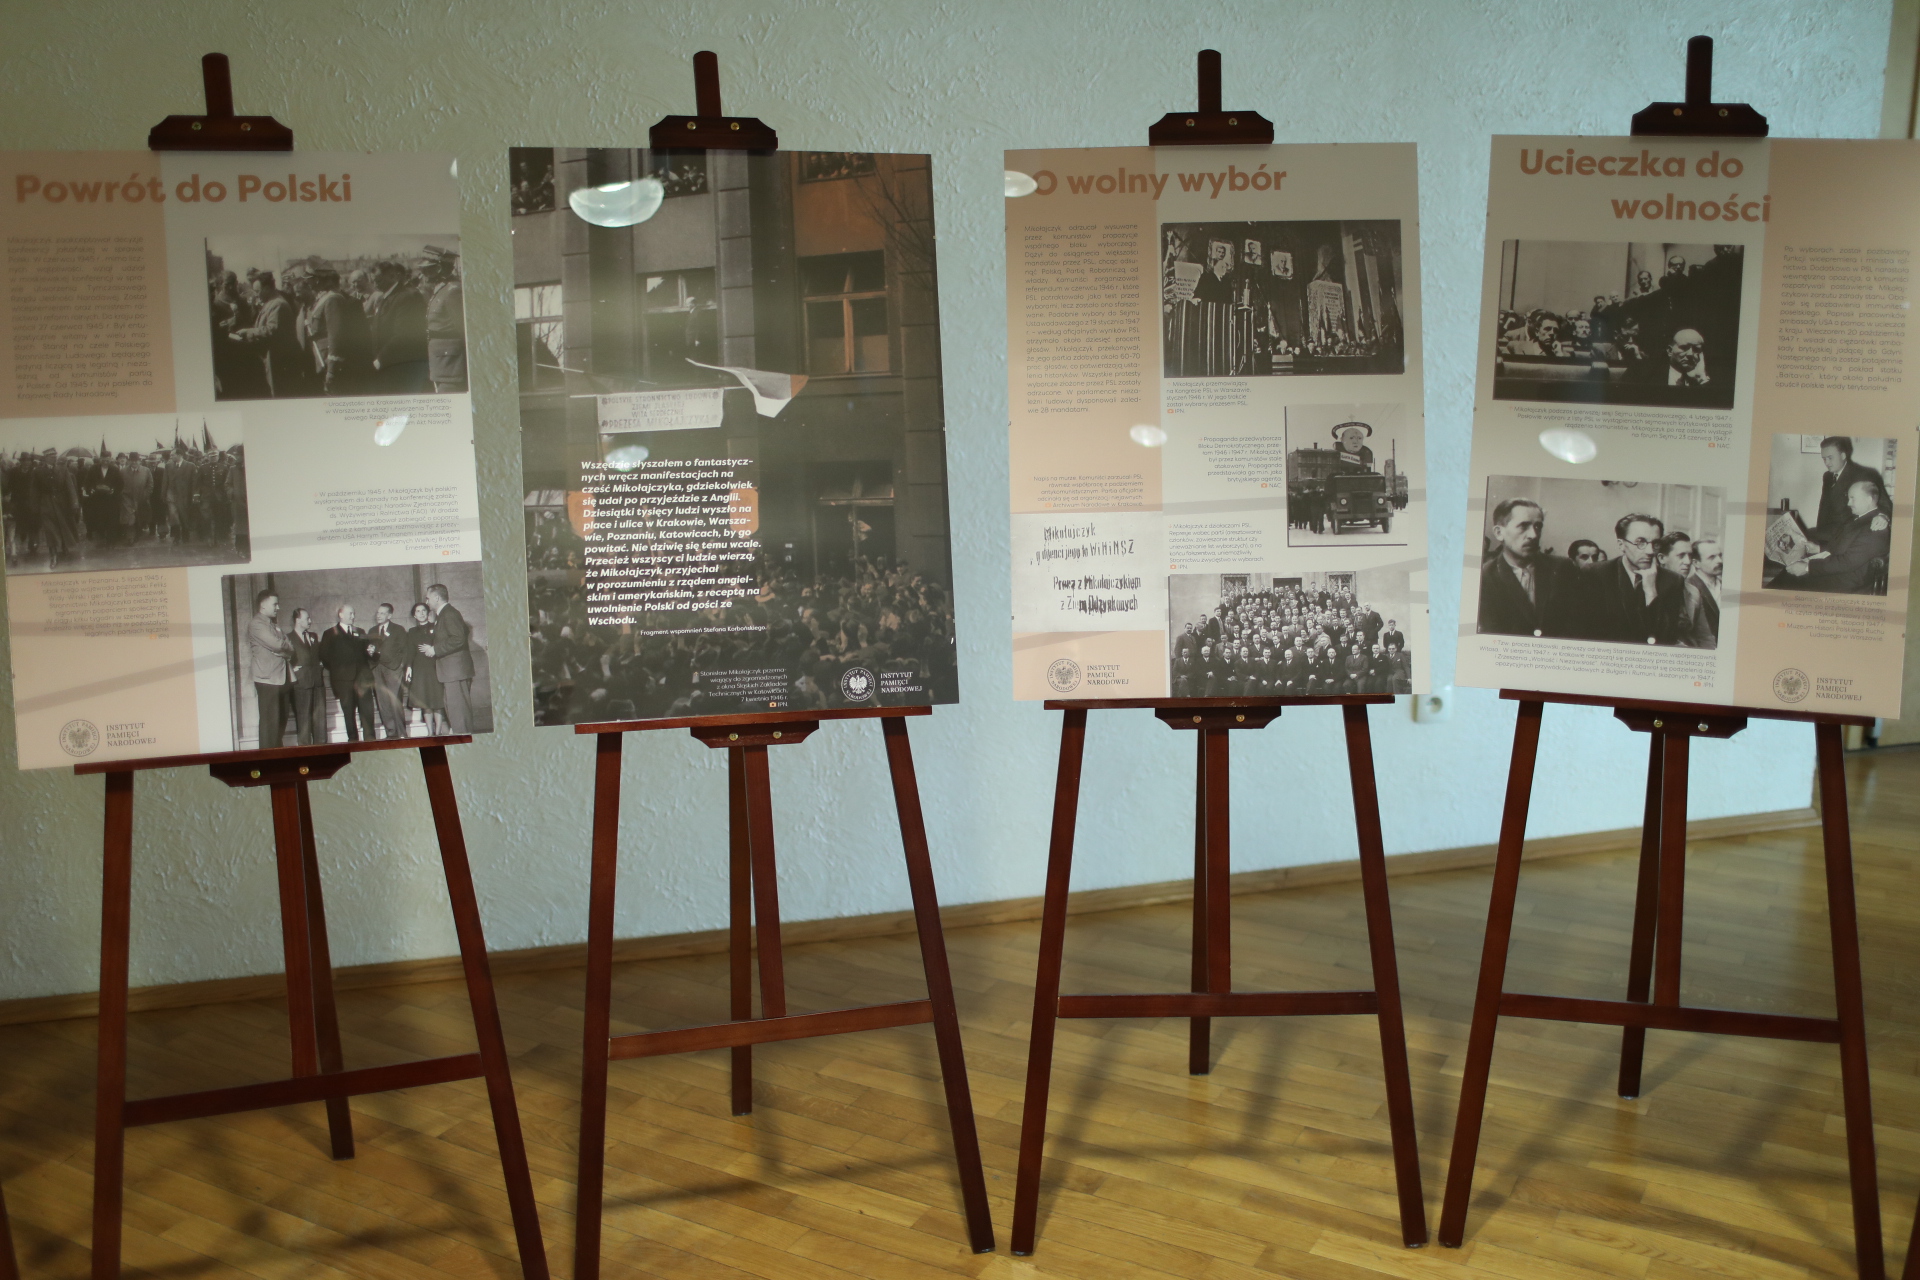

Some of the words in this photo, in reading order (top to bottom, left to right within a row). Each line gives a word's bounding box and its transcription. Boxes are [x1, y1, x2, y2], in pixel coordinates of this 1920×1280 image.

[1520, 149, 1685, 177] Ucieczka
[1696, 151, 1744, 178] do
[16, 173, 165, 203] Powrót
[175, 174, 226, 203] do
[238, 174, 352, 202] Polski
[1033, 170, 1058, 196] O
[1067, 168, 1170, 200] wolny
[1179, 164, 1287, 199] wybór
[1611, 193, 1771, 222] wolności
[630, 459, 682, 470] słyszałem
[693, 458, 754, 468] fantastycz-
[581, 472, 605, 483] nych
[607, 473, 638, 482] wręcz
[640, 469, 718, 480] manifestacjach
[581, 484, 610, 494] cześć
[612, 482, 683, 494] Mikołajczyka,
[685, 480, 753, 493] gdziekolwiek
[582, 496, 596, 507] się
[598, 495, 621, 505] udał
[623, 497, 637, 506] po
[639, 493, 699, 506] przyjeździe
[709, 492, 741, 503] Anglii.
[583, 507, 634, 519] Dziesiątki
[636, 507, 672, 518] tysięcy
[674, 505, 699, 515] ludzi
[701, 504, 736, 516] wyszło
[583, 520, 611, 531] place
[618, 519, 643, 528] ulice
[655, 517, 705, 528] Krakowie,
[708, 516, 751, 526] Warsza-
[584, 532, 604, 543] wie,
[606, 531, 656, 541] Poznaniu,
[658, 528, 720, 539] Katowicach,
[722, 528, 735, 539] by
[737, 529, 752, 539] go
[584, 543, 628, 555] powitać.
[631, 543, 647, 552] Nie
[649, 542, 682, 553] dziwię
[684, 541, 699, 552] się
[701, 541, 727, 550] temu
[728, 539, 762, 549] wcale.
[585, 555, 628, 566] Przecież
[630, 556, 672, 565] wszyscy
[674, 554, 683, 563] ci
[685, 553, 716, 563] ludzie
[718, 552, 756, 562] wierzą,
[585, 568, 597, 578] że
[599, 566, 662, 578] Mikołajczyk
[664, 564, 720, 577] przyjechał
[596, 578, 666, 591] porozumieniu
[676, 577, 714, 588] rządem
[716, 575, 754, 587] angiel-
[586, 592, 610, 602] skim
[616, 589, 694, 601] amerykańskim,
[704, 587, 744, 598] receptą
[746, 588, 760, 596] na
[587, 603, 641, 614] uwolnienie
[644, 601, 674, 611] Polski
[675, 601, 689, 610] od
[691, 599, 717, 611] gości
[588, 615, 638, 626] Wschodu.
[1816, 685, 1847, 693] PAMIĘCI
[1817, 678, 1853, 686] INSTYTUT
[1816, 692, 1862, 701] NARODOWEJ
[107, 723, 145, 731] INSTYTUT
[107, 731, 139, 740] PAMIĘCI
[107, 738, 156, 747] NARODOWEJ
